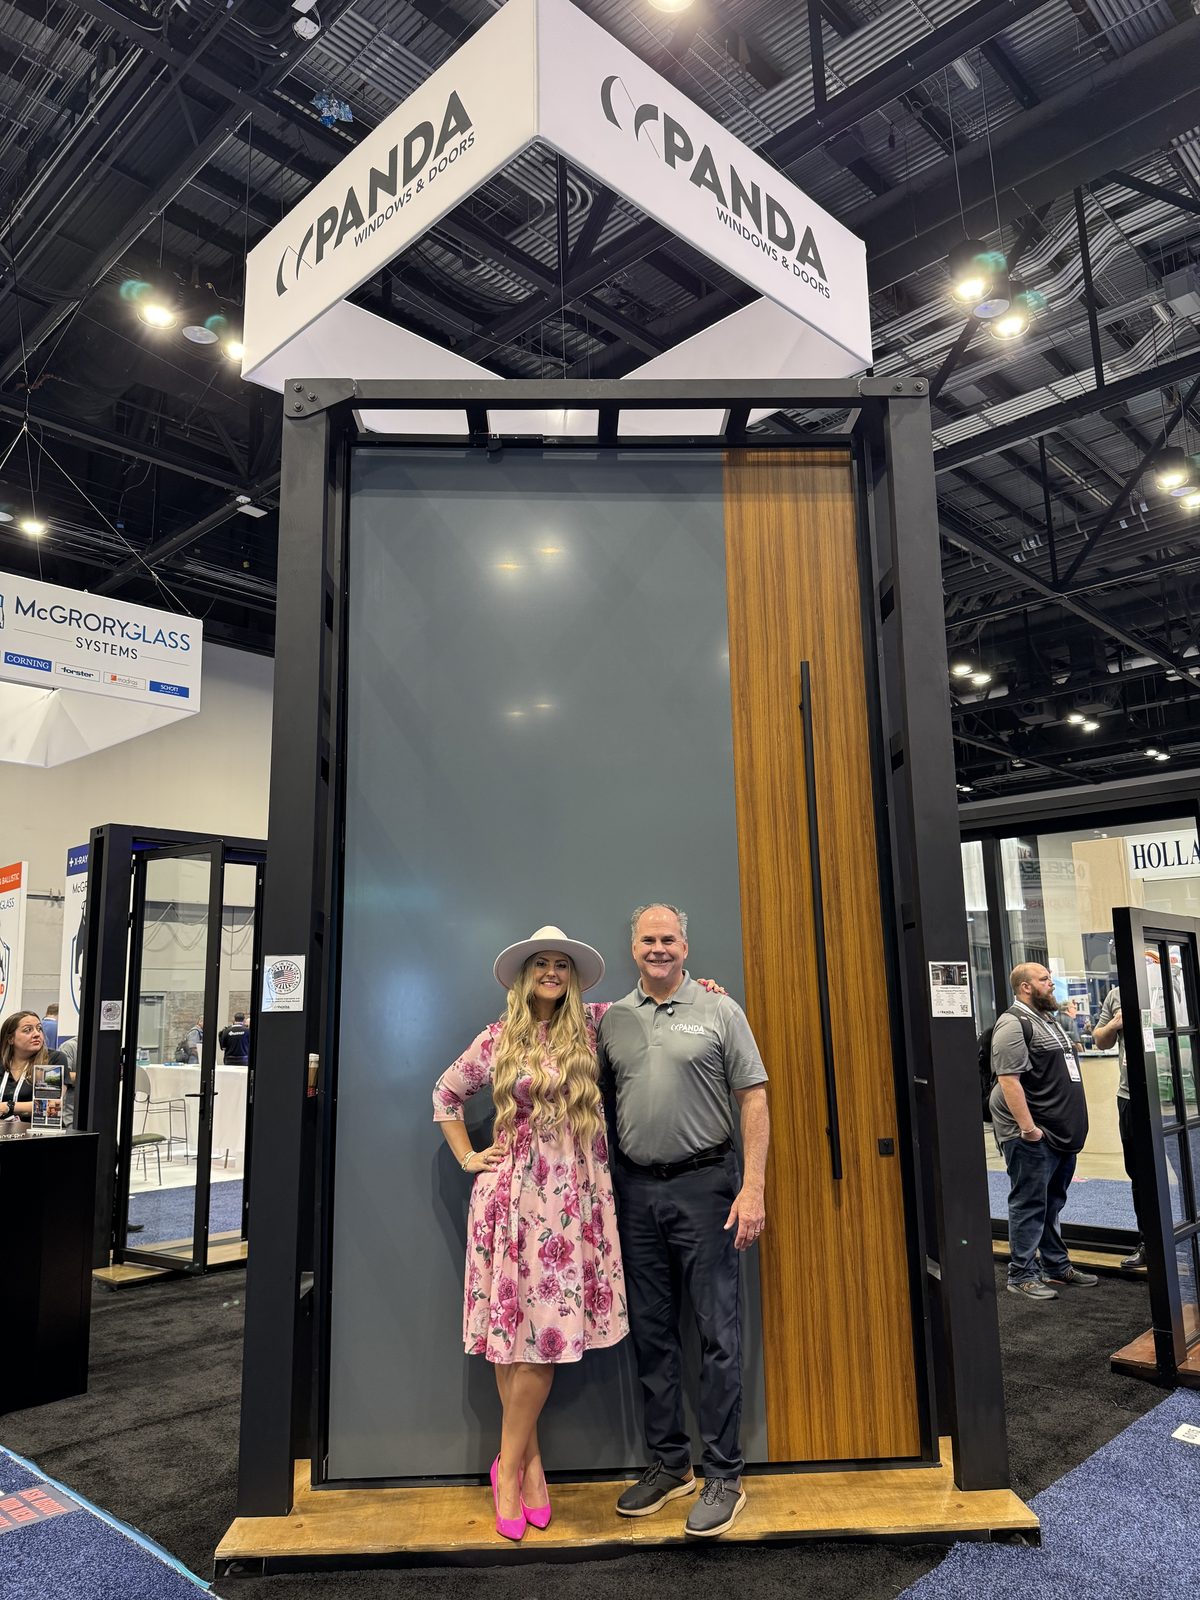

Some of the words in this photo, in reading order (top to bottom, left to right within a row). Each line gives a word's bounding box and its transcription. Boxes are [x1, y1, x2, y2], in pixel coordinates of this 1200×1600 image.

[315, 90, 473, 265] PANDA
[354, 190, 412, 248] WINDOWS
[415, 178, 425, 194] &
[428, 131, 475, 183] DOORS
[663, 111, 829, 283] PANDA
[715, 206, 779, 261] WINDOWS
[780, 254, 790, 271] &
[792, 262, 831, 299] DOORS
[6, 654, 50, 670] CORNING
[75, 636, 139, 660] SYSTEMS
[60, 667, 94, 679] forster
[1131, 839, 1200, 870] HOLLA
[678, 1023, 705, 1033] PANDA
